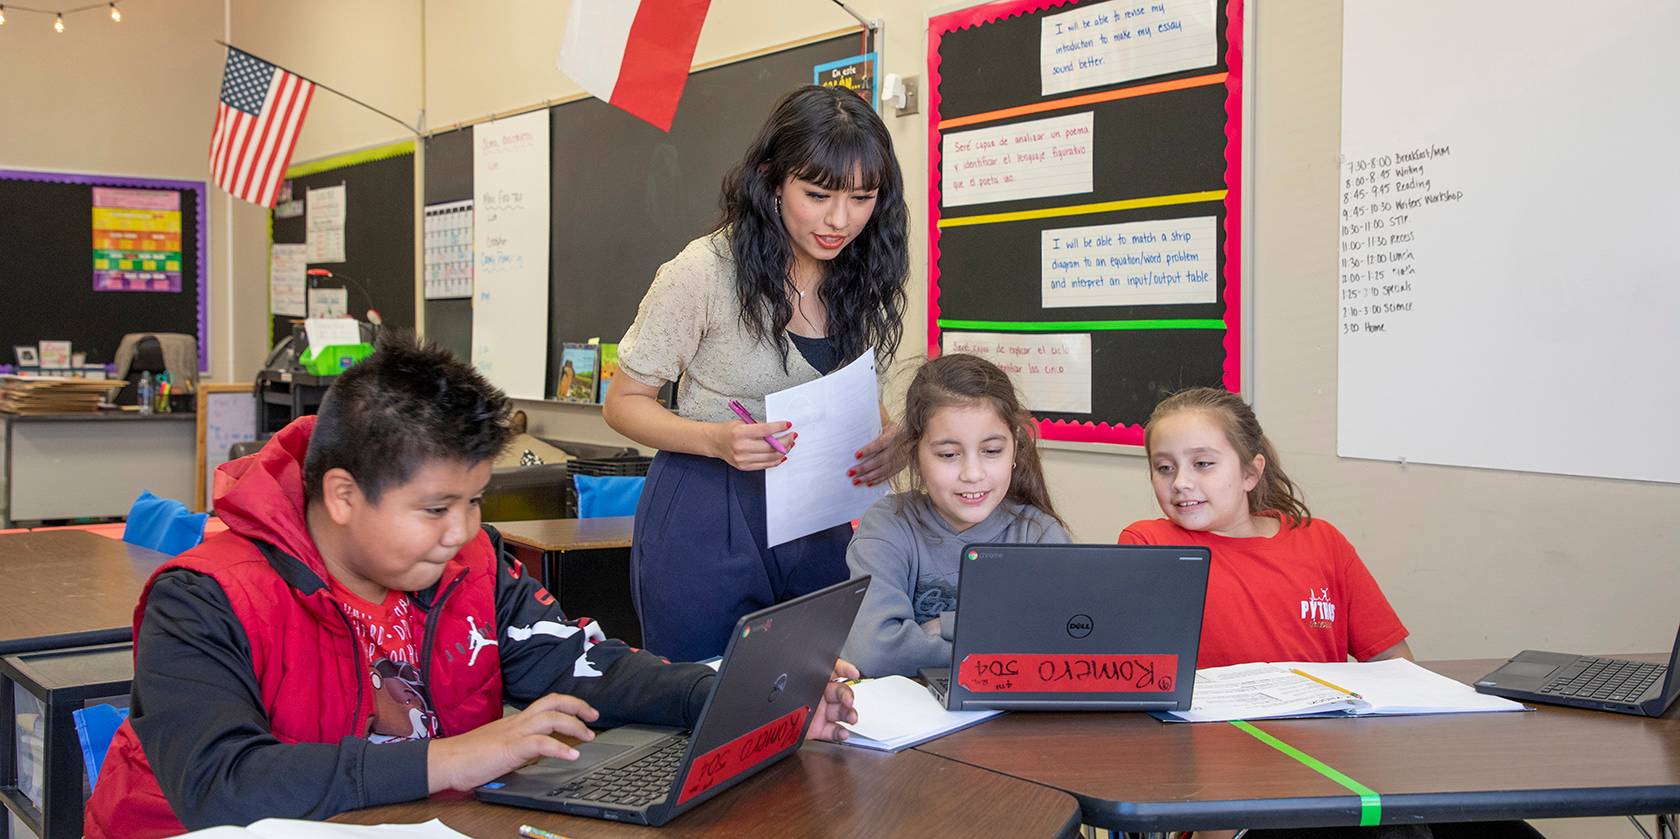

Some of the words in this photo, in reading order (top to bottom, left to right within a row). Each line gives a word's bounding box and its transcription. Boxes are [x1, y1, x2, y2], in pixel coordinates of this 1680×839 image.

[1055, 23, 1063, 35] I
[1067, 24, 1079, 32] will
[1083, 20, 1091, 28] be
[1094, 16, 1109, 26] able
[1114, 12, 1121, 22] to
[1124, 7, 1145, 19] revise
[1151, 4, 1165, 14] my
[1055, 38, 1094, 54] introduction
[1099, 34, 1108, 44] to
[1113, 30, 1132, 41] make
[1137, 27, 1152, 38] my
[1157, 21, 1183, 36] essay
[1052, 63, 1073, 75] sound
[1000, 137, 1008, 145] de
[1051, 131, 1061, 139] un
[1065, 127, 1089, 139] poema
[1003, 154, 1011, 165] el
[1395, 165, 1424, 177] Writing
[1395, 178, 1431, 192] Reading
[1424, 190, 1463, 204] Workshop
[1052, 238, 1060, 250] I
[1066, 239, 1079, 249] will
[1083, 238, 1092, 248] be
[1096, 235, 1112, 247] able
[1118, 233, 1126, 245] to
[1131, 232, 1156, 244] match
[1161, 234, 1167, 243] a
[1171, 231, 1192, 244] strip
[1052, 259, 1080, 272] diagram
[1084, 256, 1092, 267] to
[1096, 258, 1106, 267] an
[1110, 252, 1161, 269] equation/word
[1166, 251, 1199, 265] problem
[1051, 279, 1066, 289] and
[1071, 276, 1104, 289] interpret
[1109, 277, 1120, 286] an
[1127, 271, 1182, 288] input/output
[1383, 301, 1413, 313] Science
[1364, 321, 1386, 333] Home
[996, 343, 1005, 353] de
[1037, 345, 1046, 354] el
[977, 660, 1018, 676] 504
[1039, 660, 1154, 688] Romero
